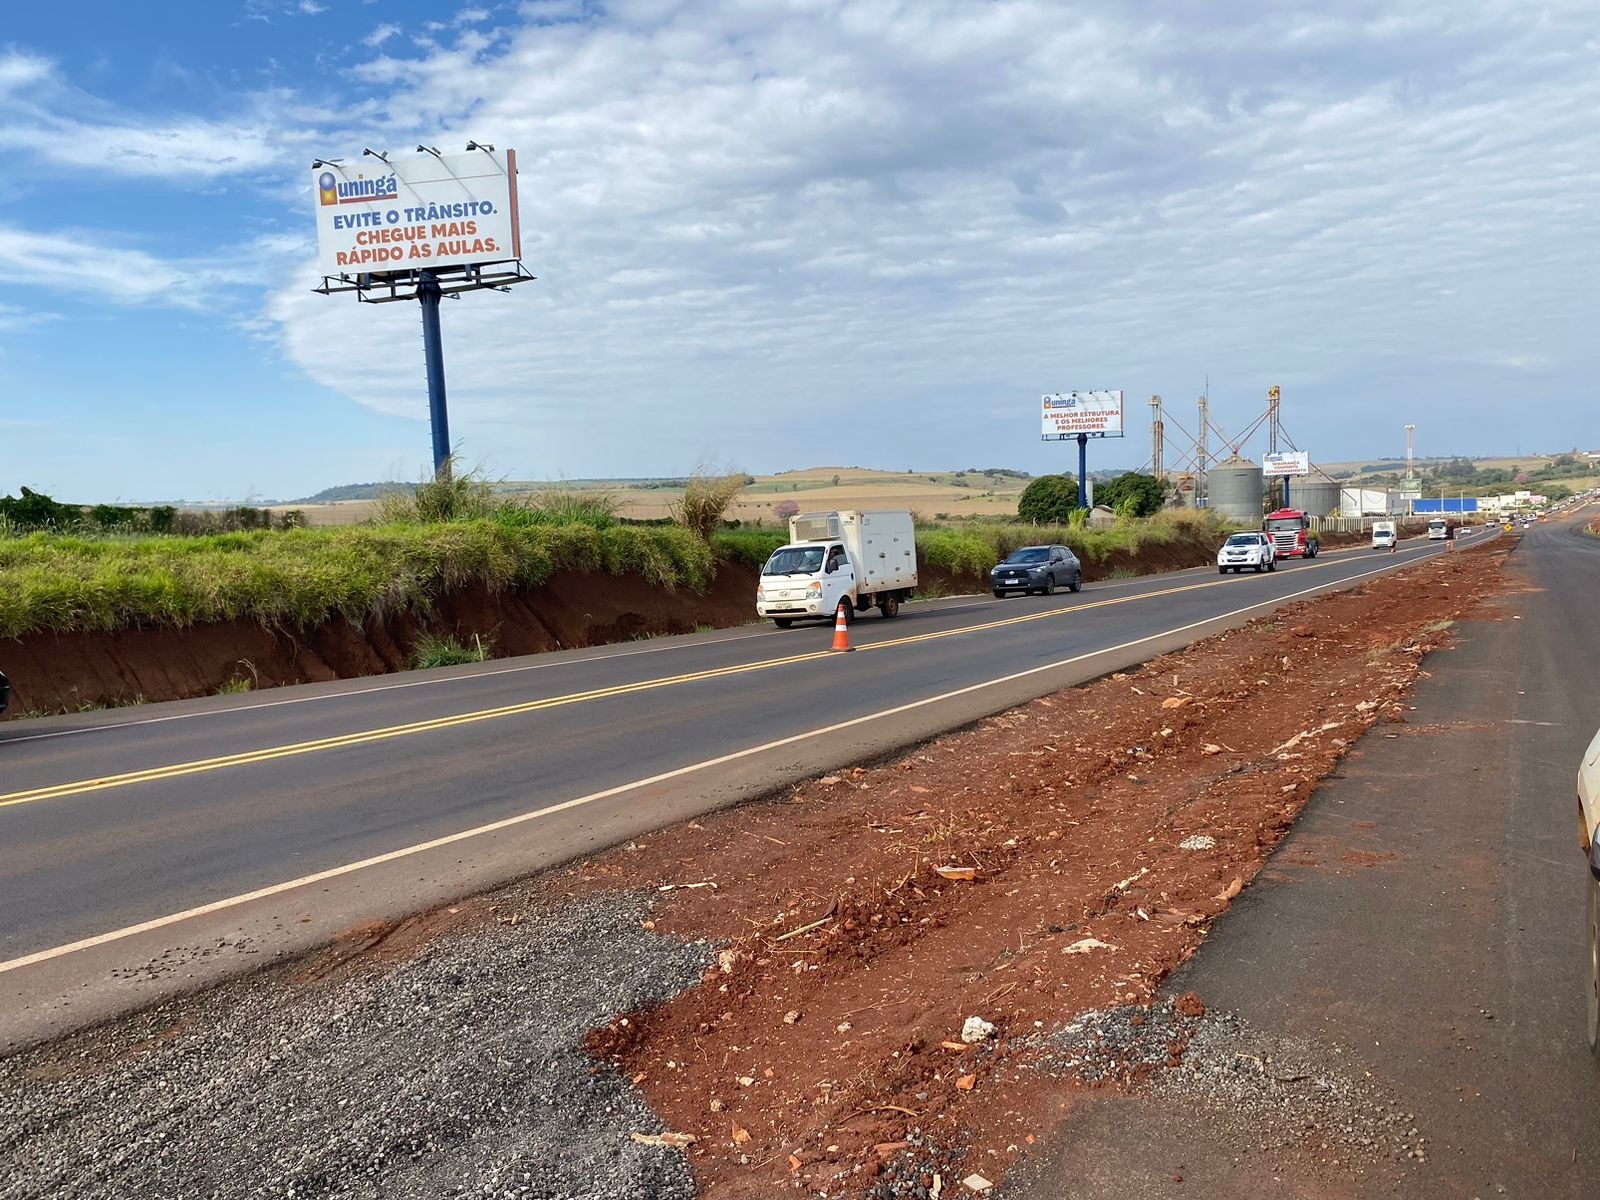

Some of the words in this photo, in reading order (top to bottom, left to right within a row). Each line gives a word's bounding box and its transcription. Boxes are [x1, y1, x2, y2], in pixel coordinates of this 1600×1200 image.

[334, 210, 382, 230] EVITE
[386, 210, 399, 224] O
[404, 200, 498, 222] TRÂNSITO.
[356, 225, 426, 246] CHEGUE
[431, 220, 477, 238] MAIS
[336, 246, 404, 266] RÁPIDO
[408, 241, 432, 258] ÀS
[436, 237, 500, 256] AULAS.
